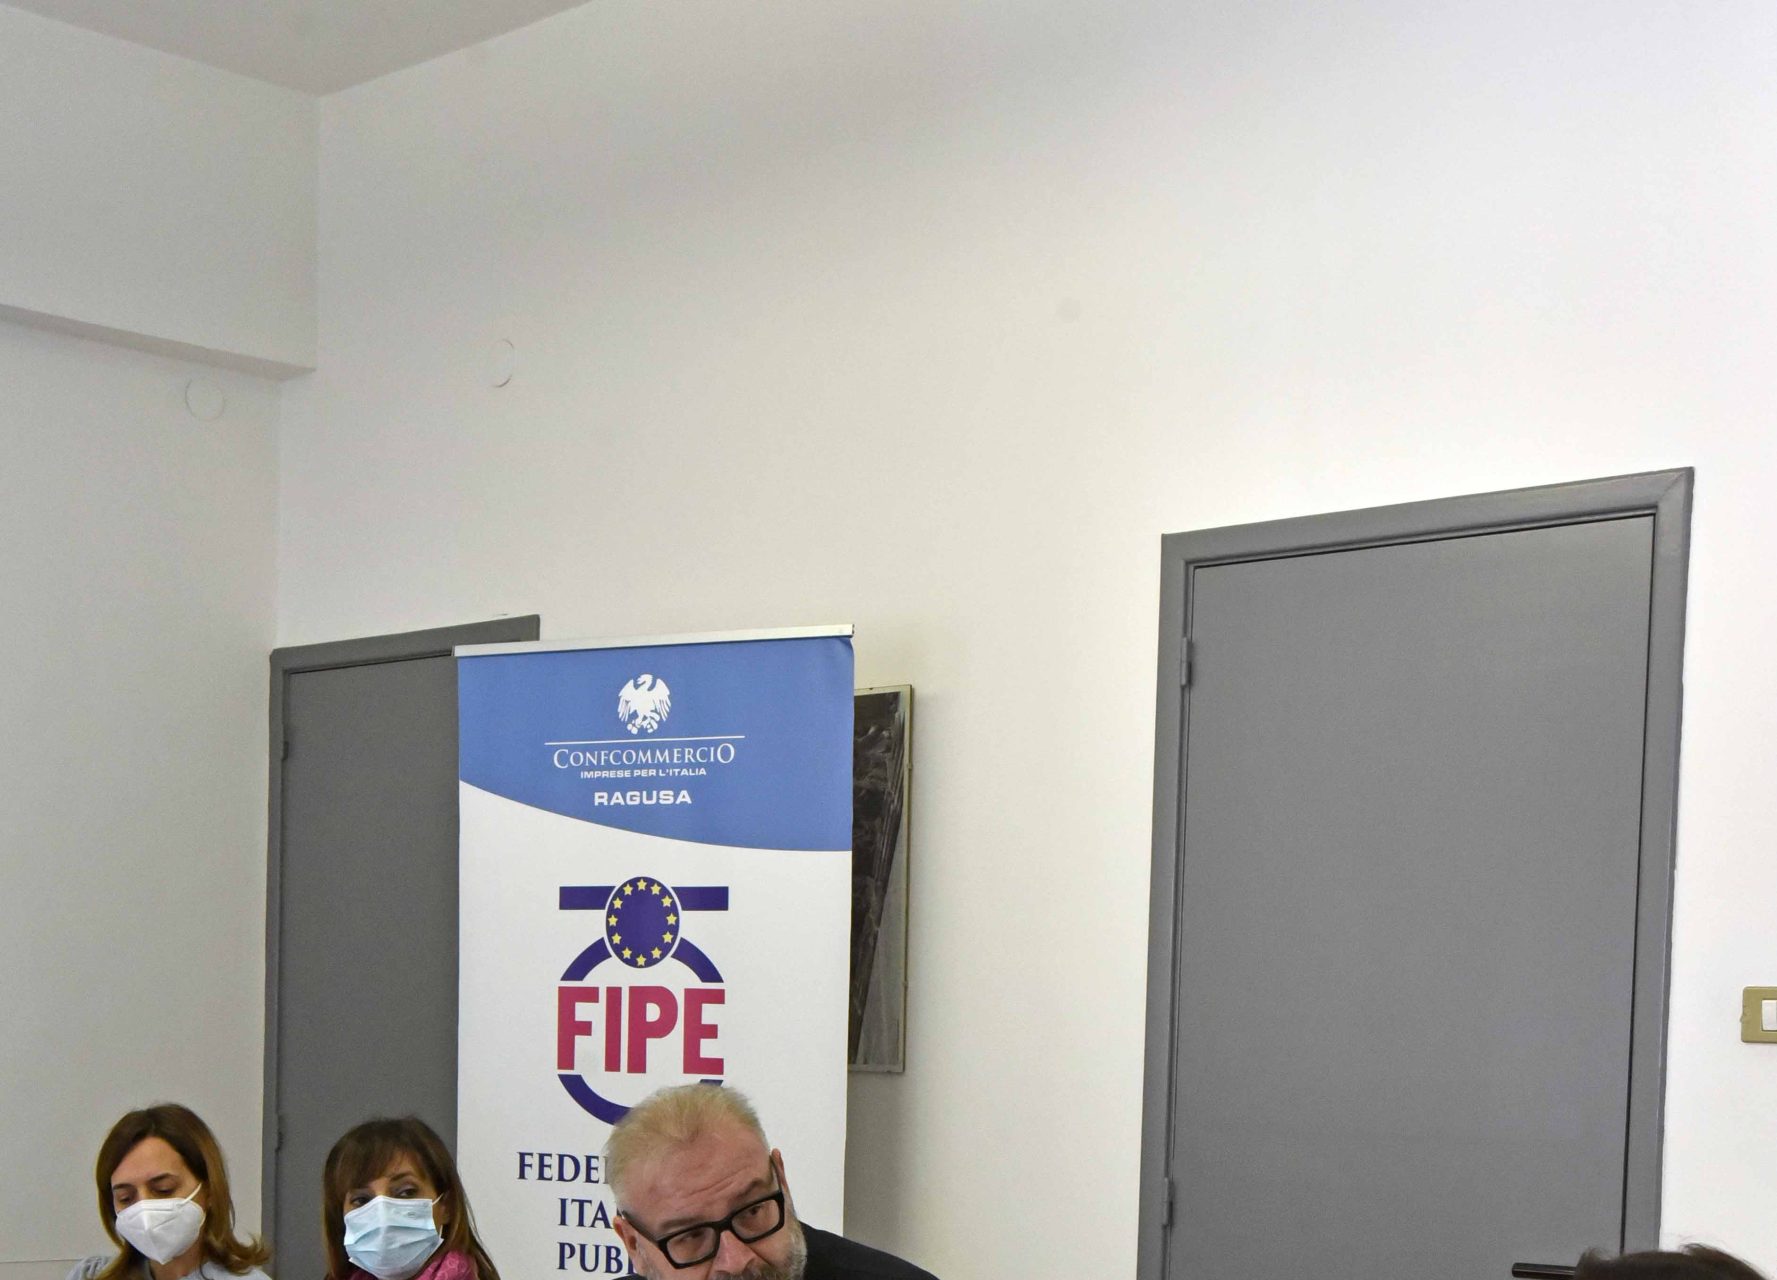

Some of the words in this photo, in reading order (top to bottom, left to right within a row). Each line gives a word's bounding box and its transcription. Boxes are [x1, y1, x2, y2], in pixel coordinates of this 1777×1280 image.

[580, 770, 631, 779] IMPRESE
[633, 769, 656, 777] PER
[659, 767, 707, 777] L'ITALIA
[594, 789, 692, 806] RAGUSA
[557, 986, 726, 1075] FIPE
